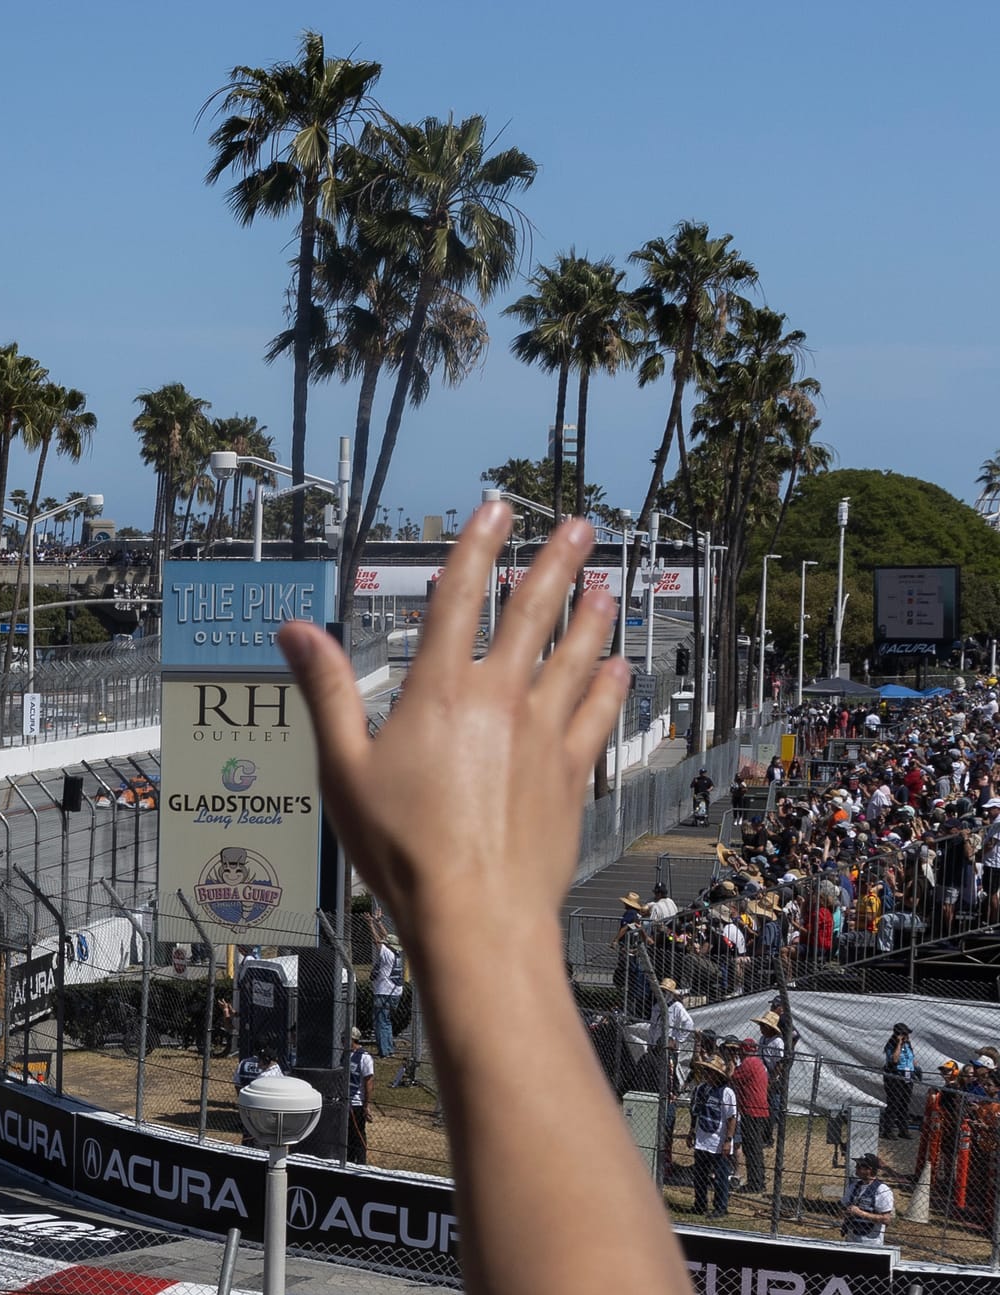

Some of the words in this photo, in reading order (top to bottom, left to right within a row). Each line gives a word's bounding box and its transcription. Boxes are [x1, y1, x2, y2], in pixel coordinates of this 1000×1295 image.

[356, 569, 378, 581] ing
[653, 579, 681, 593] Taco
[172, 582, 234, 624] THE
[242, 582, 315, 623] PIKE
[886, 643, 937, 655] ACURA
[192, 684, 291, 728] RH
[193, 731, 290, 742] OUTLET
[168, 793, 312, 814] GLADSTONE'S
[193, 807, 233, 829] Long
[237, 807, 283, 825] Beach
[103, 1148, 249, 1218] ACURA
